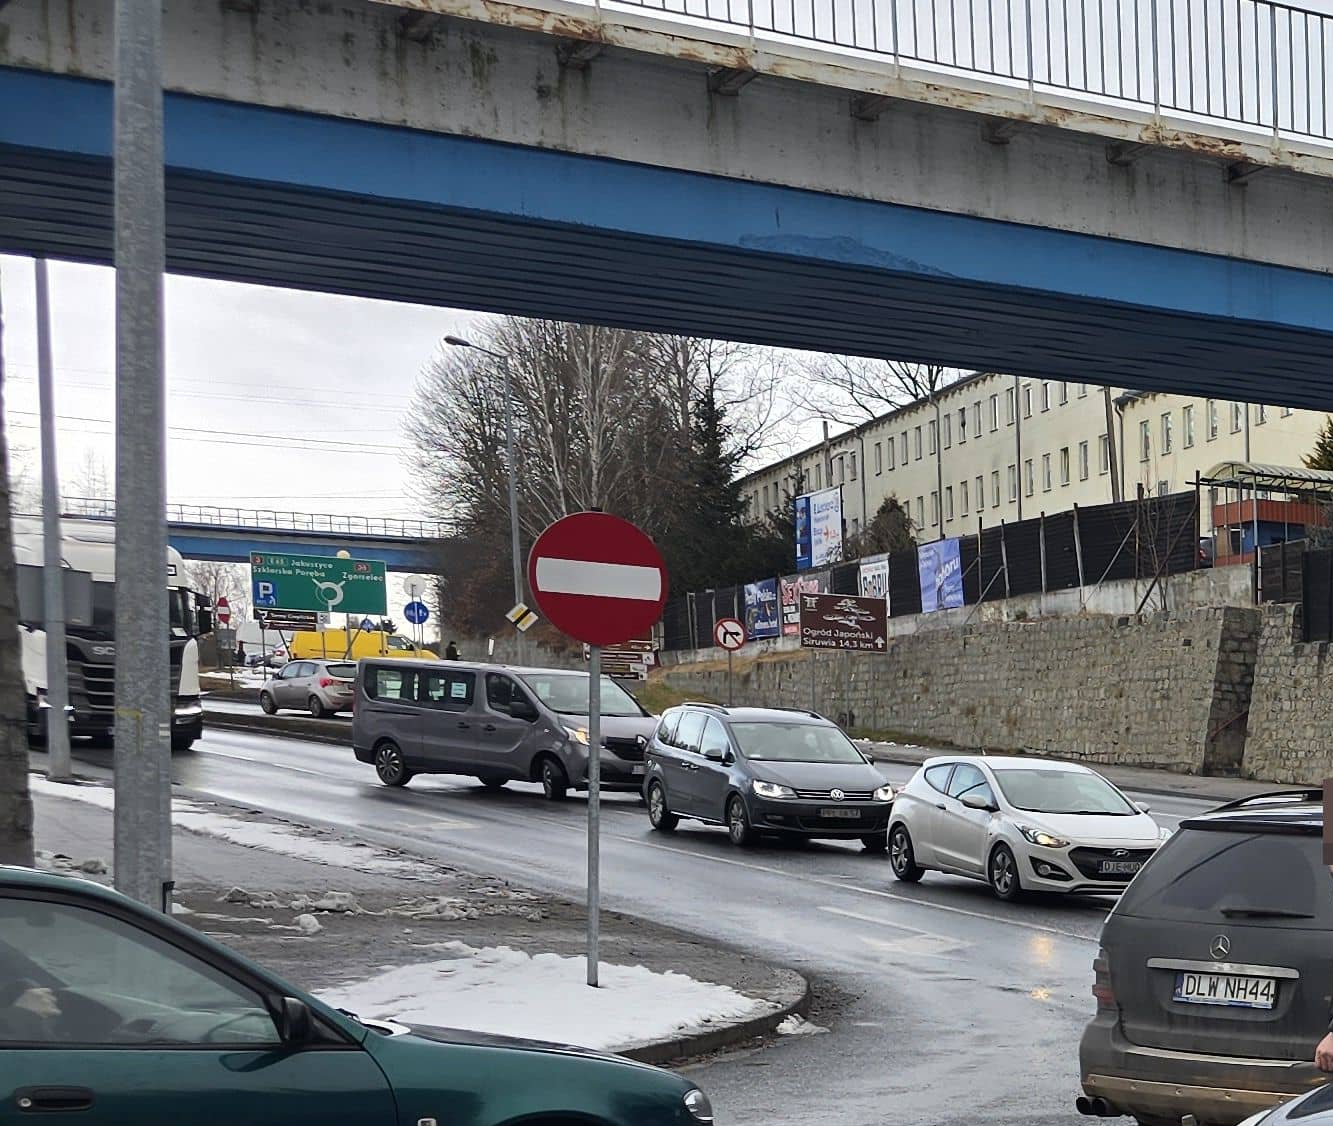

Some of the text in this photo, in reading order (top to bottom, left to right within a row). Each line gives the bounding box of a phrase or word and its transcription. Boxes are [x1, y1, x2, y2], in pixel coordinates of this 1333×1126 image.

[253, 566, 325, 577] Szklarska Poręba
[342, 572, 383, 582] Zgorzelec
[803, 627, 832, 638] Ogród
[834, 630, 873, 639] Japoński
[803, 637, 836, 647] Siruwia
[860, 641, 874, 649] km
[1185, 975, 1271, 1002] DLW NH44
